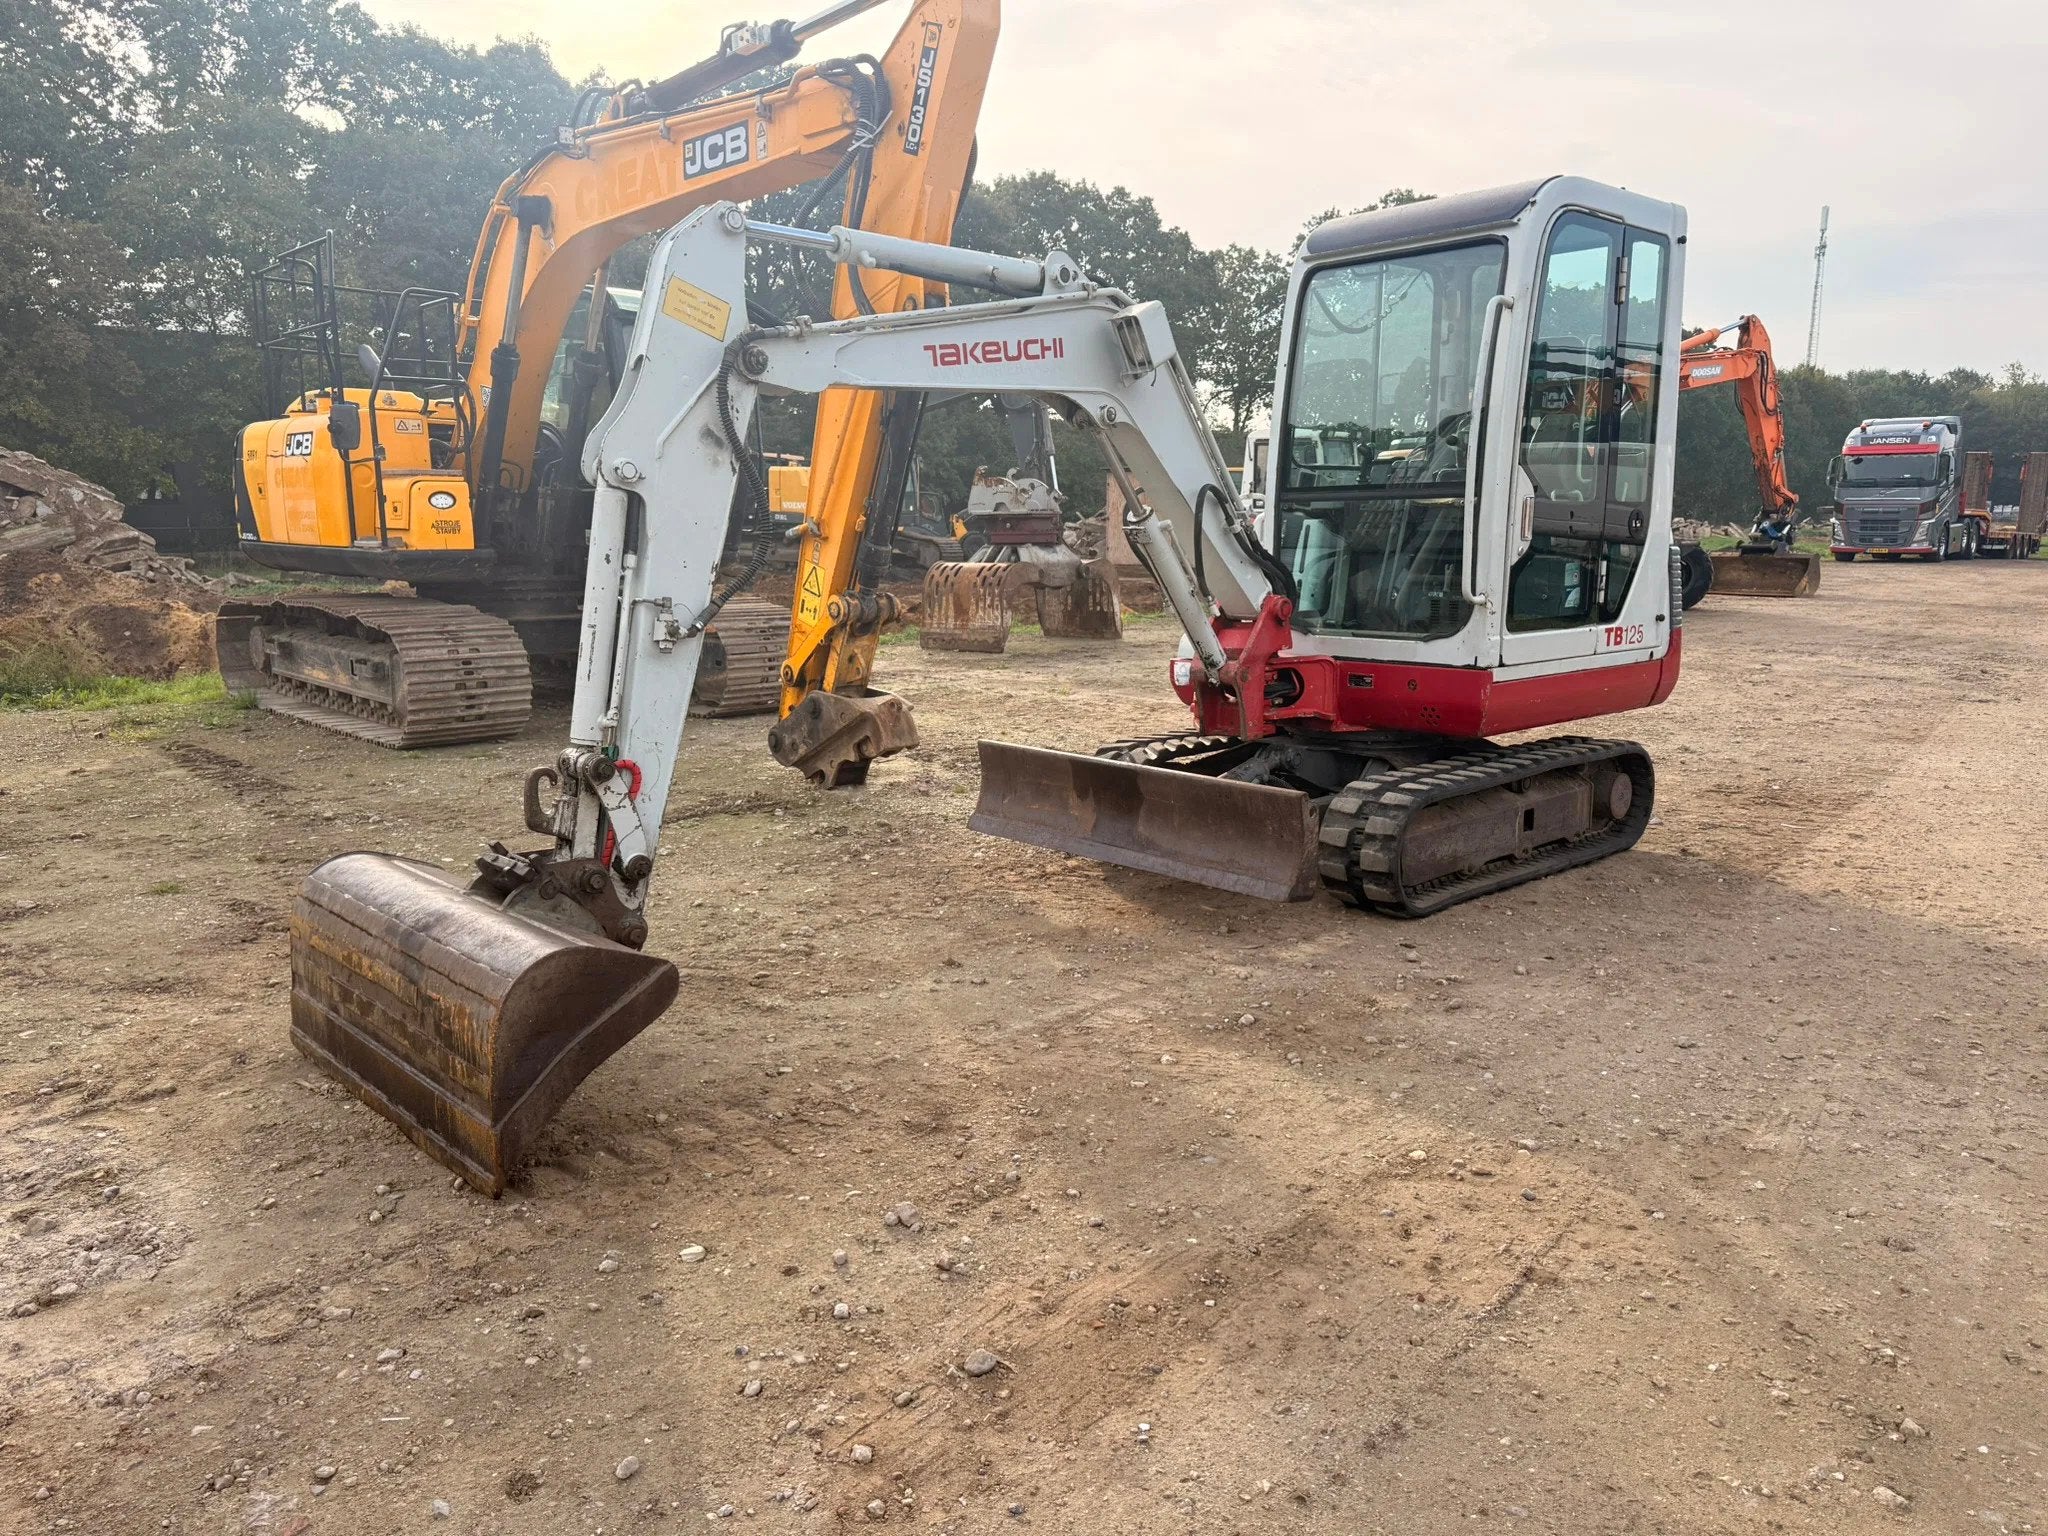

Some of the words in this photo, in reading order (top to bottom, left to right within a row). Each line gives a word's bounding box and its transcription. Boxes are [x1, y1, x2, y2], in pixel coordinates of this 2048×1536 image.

[907, 50, 936, 143] JS130
[685, 126, 747, 175] JCB
[923, 337, 1064, 367] TAKEUCHI
[1692, 366, 1721, 377] DOOSAN
[286, 433, 312, 456] JCB
[1869, 437, 1911, 445] JANSEN
[1604, 624, 1644, 647] TB125
